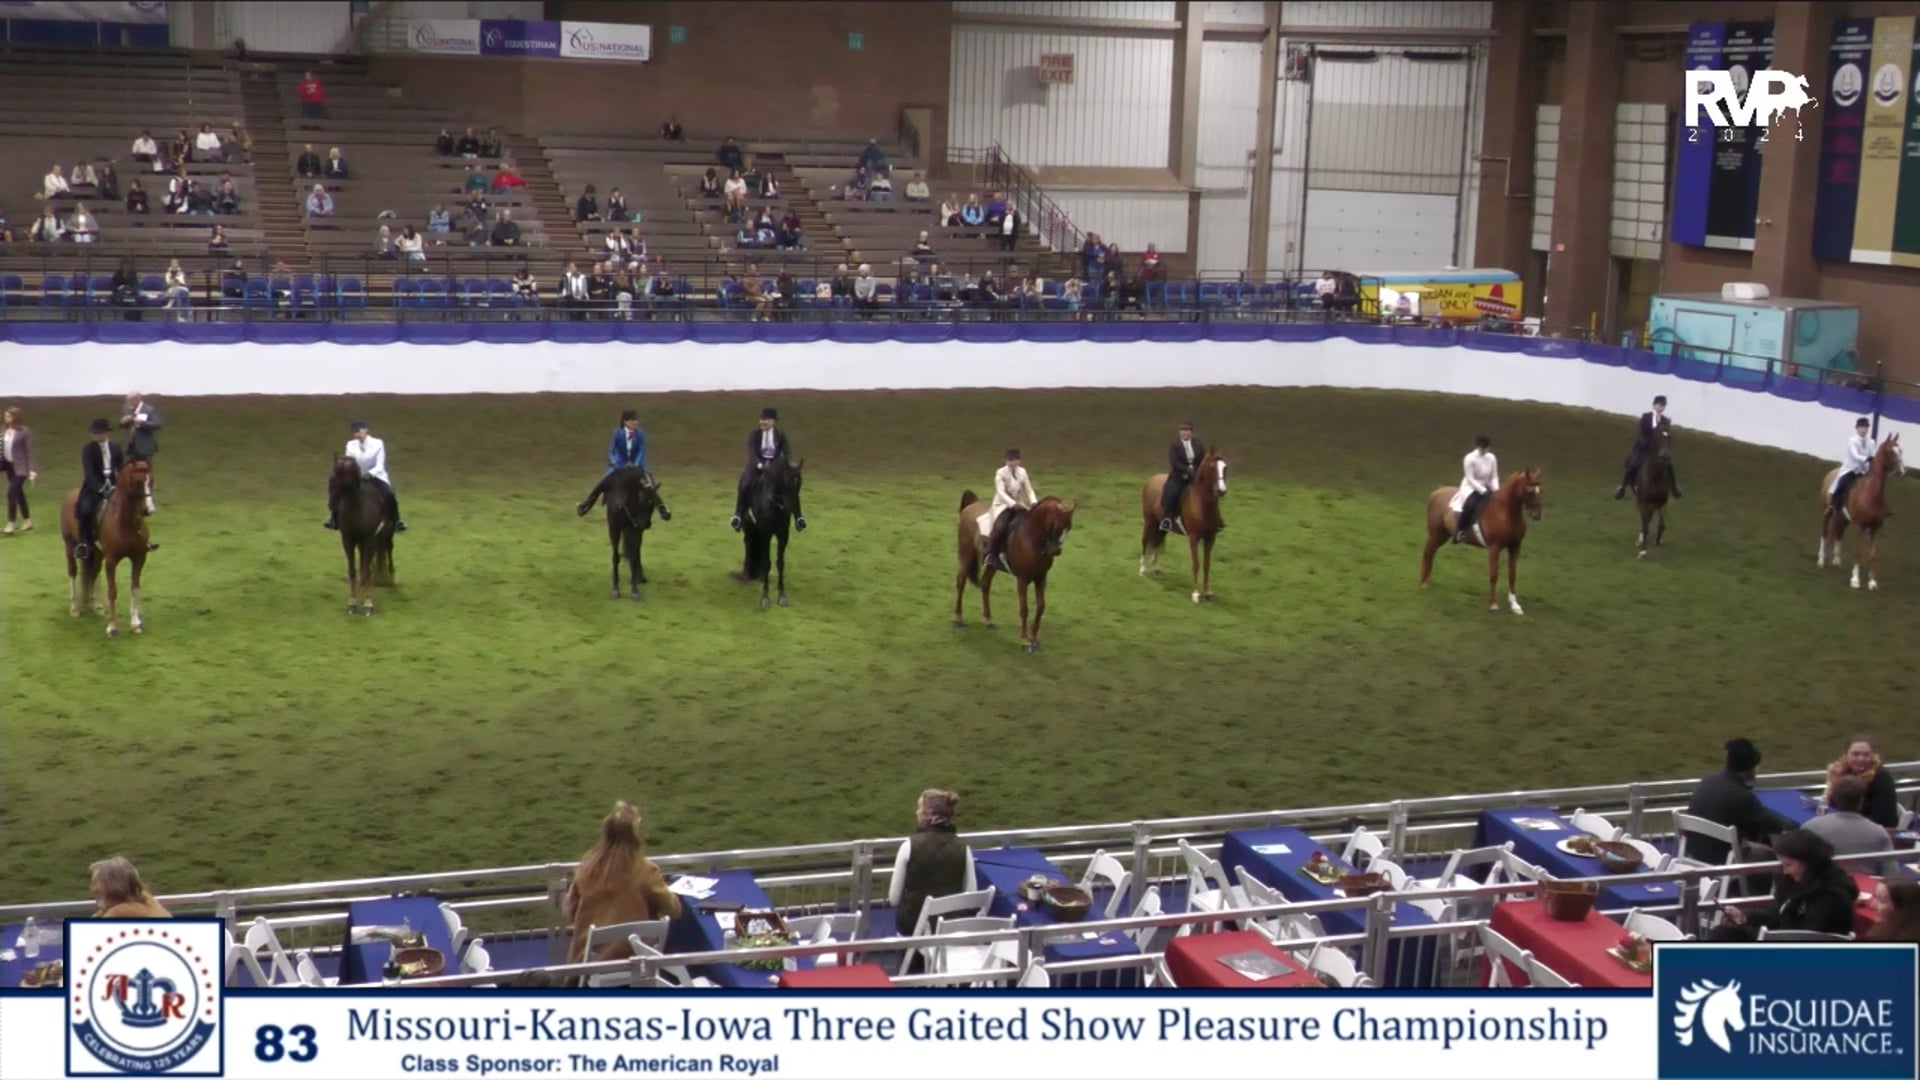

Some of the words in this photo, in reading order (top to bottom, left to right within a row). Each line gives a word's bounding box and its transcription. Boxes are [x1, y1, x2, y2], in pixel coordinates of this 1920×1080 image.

[504, 40, 557, 50] EQUESTRIAN
[582, 42, 597, 52] US
[599, 43, 645, 52] NATIONAL
[1041, 55, 1070, 67] FIRE
[1041, 69, 1072, 81] EXIT
[1440, 300, 1470, 310] ONLY
